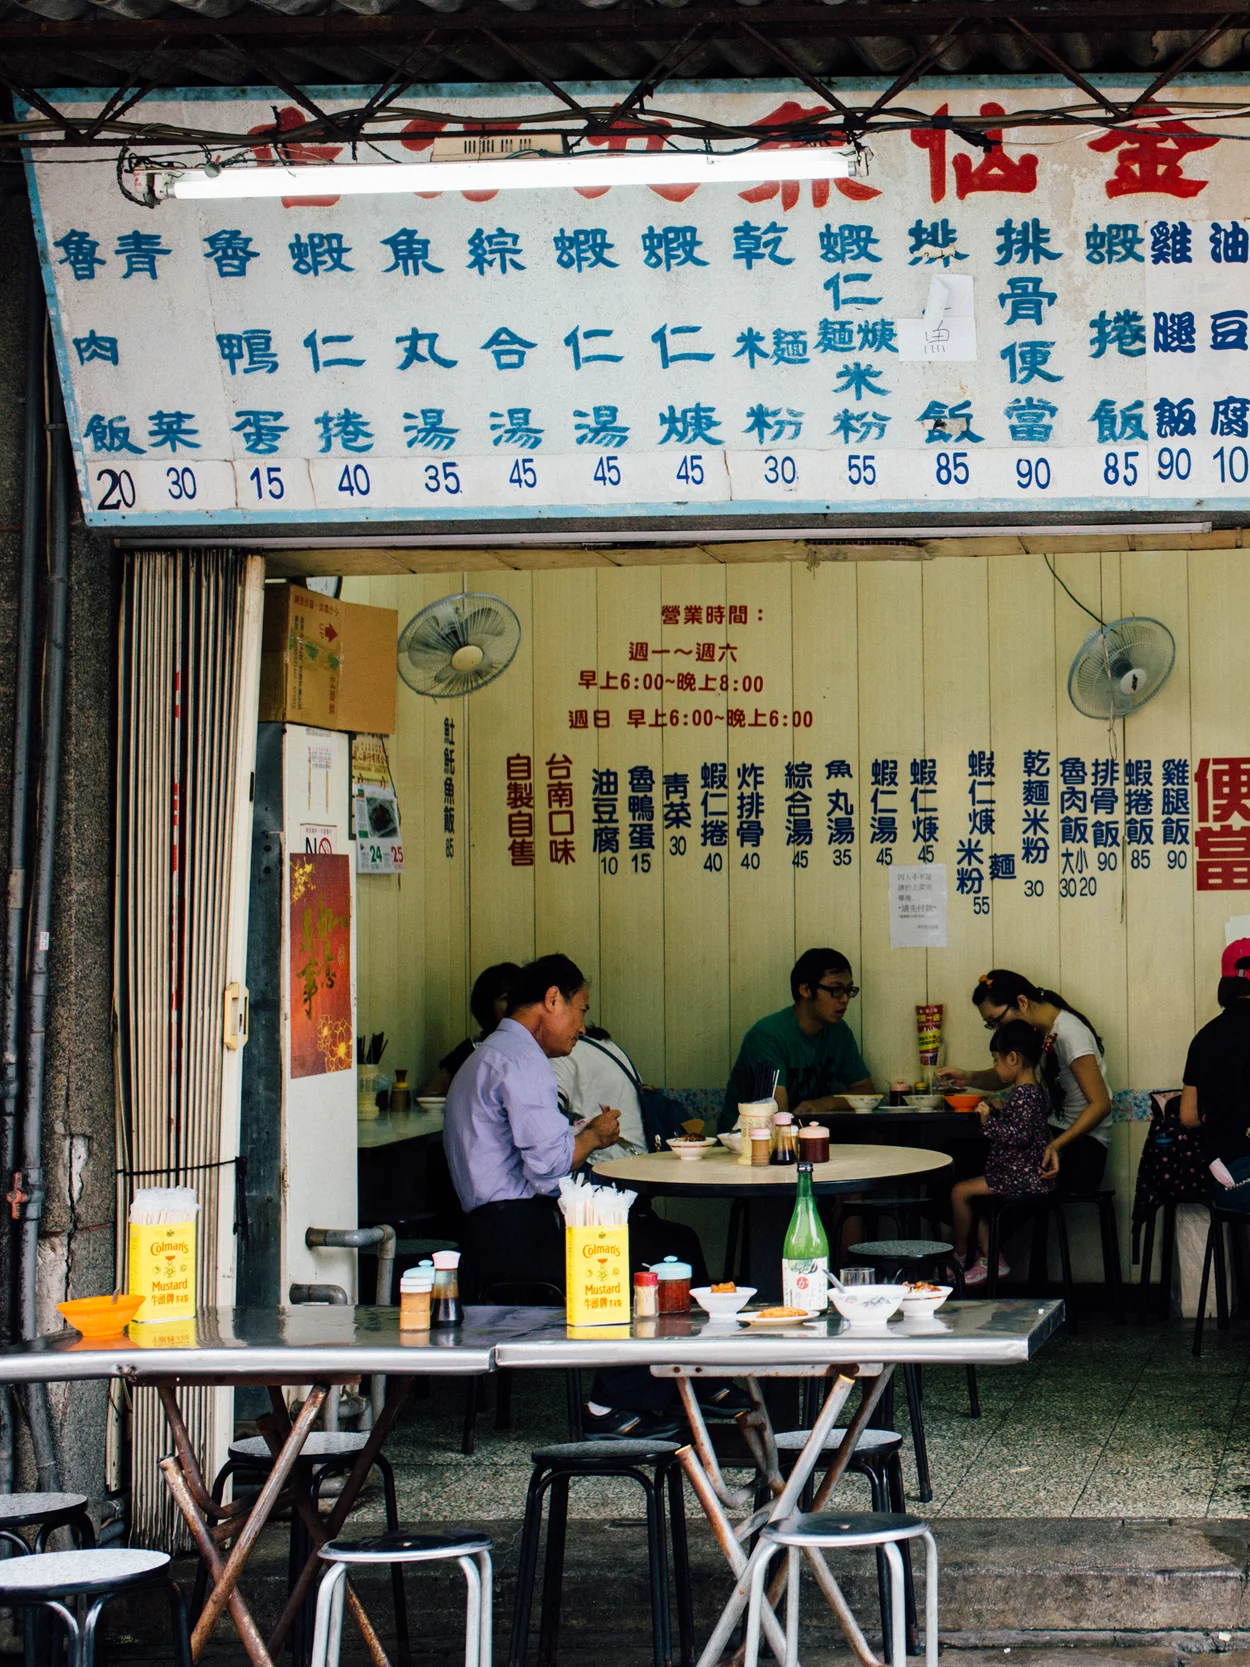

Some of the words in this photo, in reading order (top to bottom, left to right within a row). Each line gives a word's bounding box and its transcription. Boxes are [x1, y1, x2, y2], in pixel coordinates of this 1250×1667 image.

[995, 218, 1063, 442] 排骨便當
[1086, 223, 1148, 444] 蝦捲飯
[1150, 221, 1196, 438] 雞腿飯
[1210, 221, 1250, 438] 油豆腐
[113, 230, 200, 455] 青菜
[166, 467, 196, 500] 30
[204, 230, 288, 455] 魯鴨蛋
[250, 467, 284, 499] 15
[286, 233, 373, 453] 蝦仁捲
[338, 464, 370, 496] 40
[380, 228, 459, 451] 魚丸湯
[424, 462, 462, 494] 35
[466, 227, 544, 450] 綜合湯
[509, 458, 536, 488] 45
[553, 228, 630, 448] 蝦仁湯
[593, 456, 621, 486] 45
[676, 455, 704, 485] 45
[764, 455, 796, 484] 30
[848, 455, 876, 485] 55
[936, 452, 969, 485] 85
[1016, 458, 1051, 489] 90
[1104, 451, 1139, 486] 85
[1158, 447, 1191, 480] 90
[1213, 446, 1248, 483] 10
[97, 469, 137, 512] 20
[569, 710, 611, 729] 週日
[506, 753, 535, 867] 自製自售
[545, 752, 577, 866] 台南口味
[592, 768, 620, 856] 油豆腐
[662, 772, 691, 829] 青菜
[701, 762, 729, 847] 蝦仁捲
[736, 763, 764, 848] 炸排骨
[785, 761, 813, 846] 綜合湯
[825, 760, 854, 845] 魚丸湯
[870, 759, 898, 844] 蝦仁湯
[1022, 750, 1050, 864] 乾麵米粉
[1090, 759, 1120, 848] 排骨飯
[1124, 759, 1154, 845] 蝦捲飯
[1162, 759, 1189, 845] 雞腿飯
[369, 845, 382, 862] 24
[391, 846, 404, 862] 25
[669, 836, 686, 856] 30
[703, 853, 722, 872] 40
[741, 853, 760, 869] 40
[792, 850, 808, 868] 45
[833, 849, 852, 866] 35
[876, 848, 892, 865] 45
[918, 845, 934, 863] 45
[1061, 848, 1088, 874] 大小
[1098, 852, 1117, 871] 90
[1131, 850, 1150, 869] 85
[1168, 850, 1187, 869] 90
[598, 857, 618, 875] 10
[631, 853, 651, 873] 15
[957, 838, 984, 894] 米粉
[974, 897, 989, 914] 55
[1025, 880, 1044, 897] 30
[1059, 878, 1076, 897] 30
[1080, 877, 1096, 896] 20
[150, 1241, 189, 1256] Colman's
[582, 1243, 621, 1259] Colman's
[151, 1278, 188, 1292] Mustard
[585, 1282, 621, 1296] Mustard
